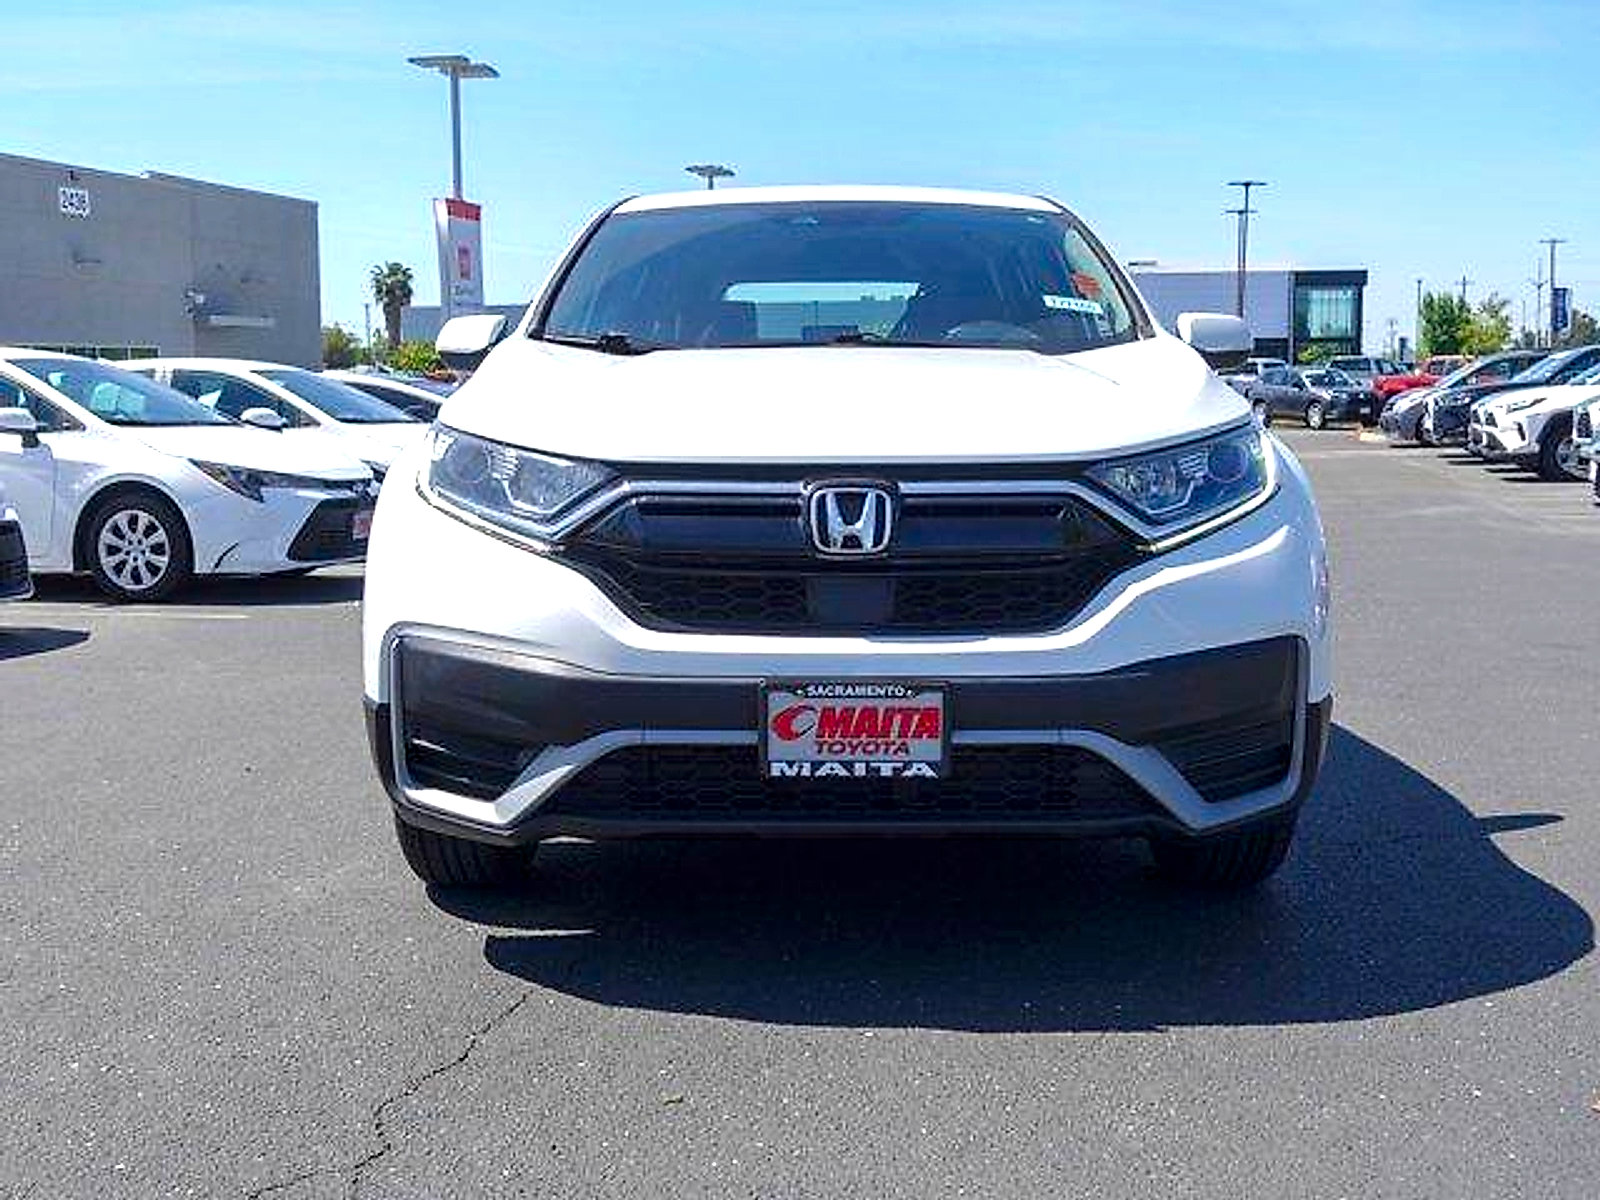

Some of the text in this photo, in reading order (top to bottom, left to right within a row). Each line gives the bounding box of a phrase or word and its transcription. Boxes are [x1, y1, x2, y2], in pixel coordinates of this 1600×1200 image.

[807, 684, 906, 698] SACRAMENTO
[815, 706, 941, 739] MAITA
[814, 740, 910, 756] TOYOTA
[769, 761, 939, 778] MAITA
